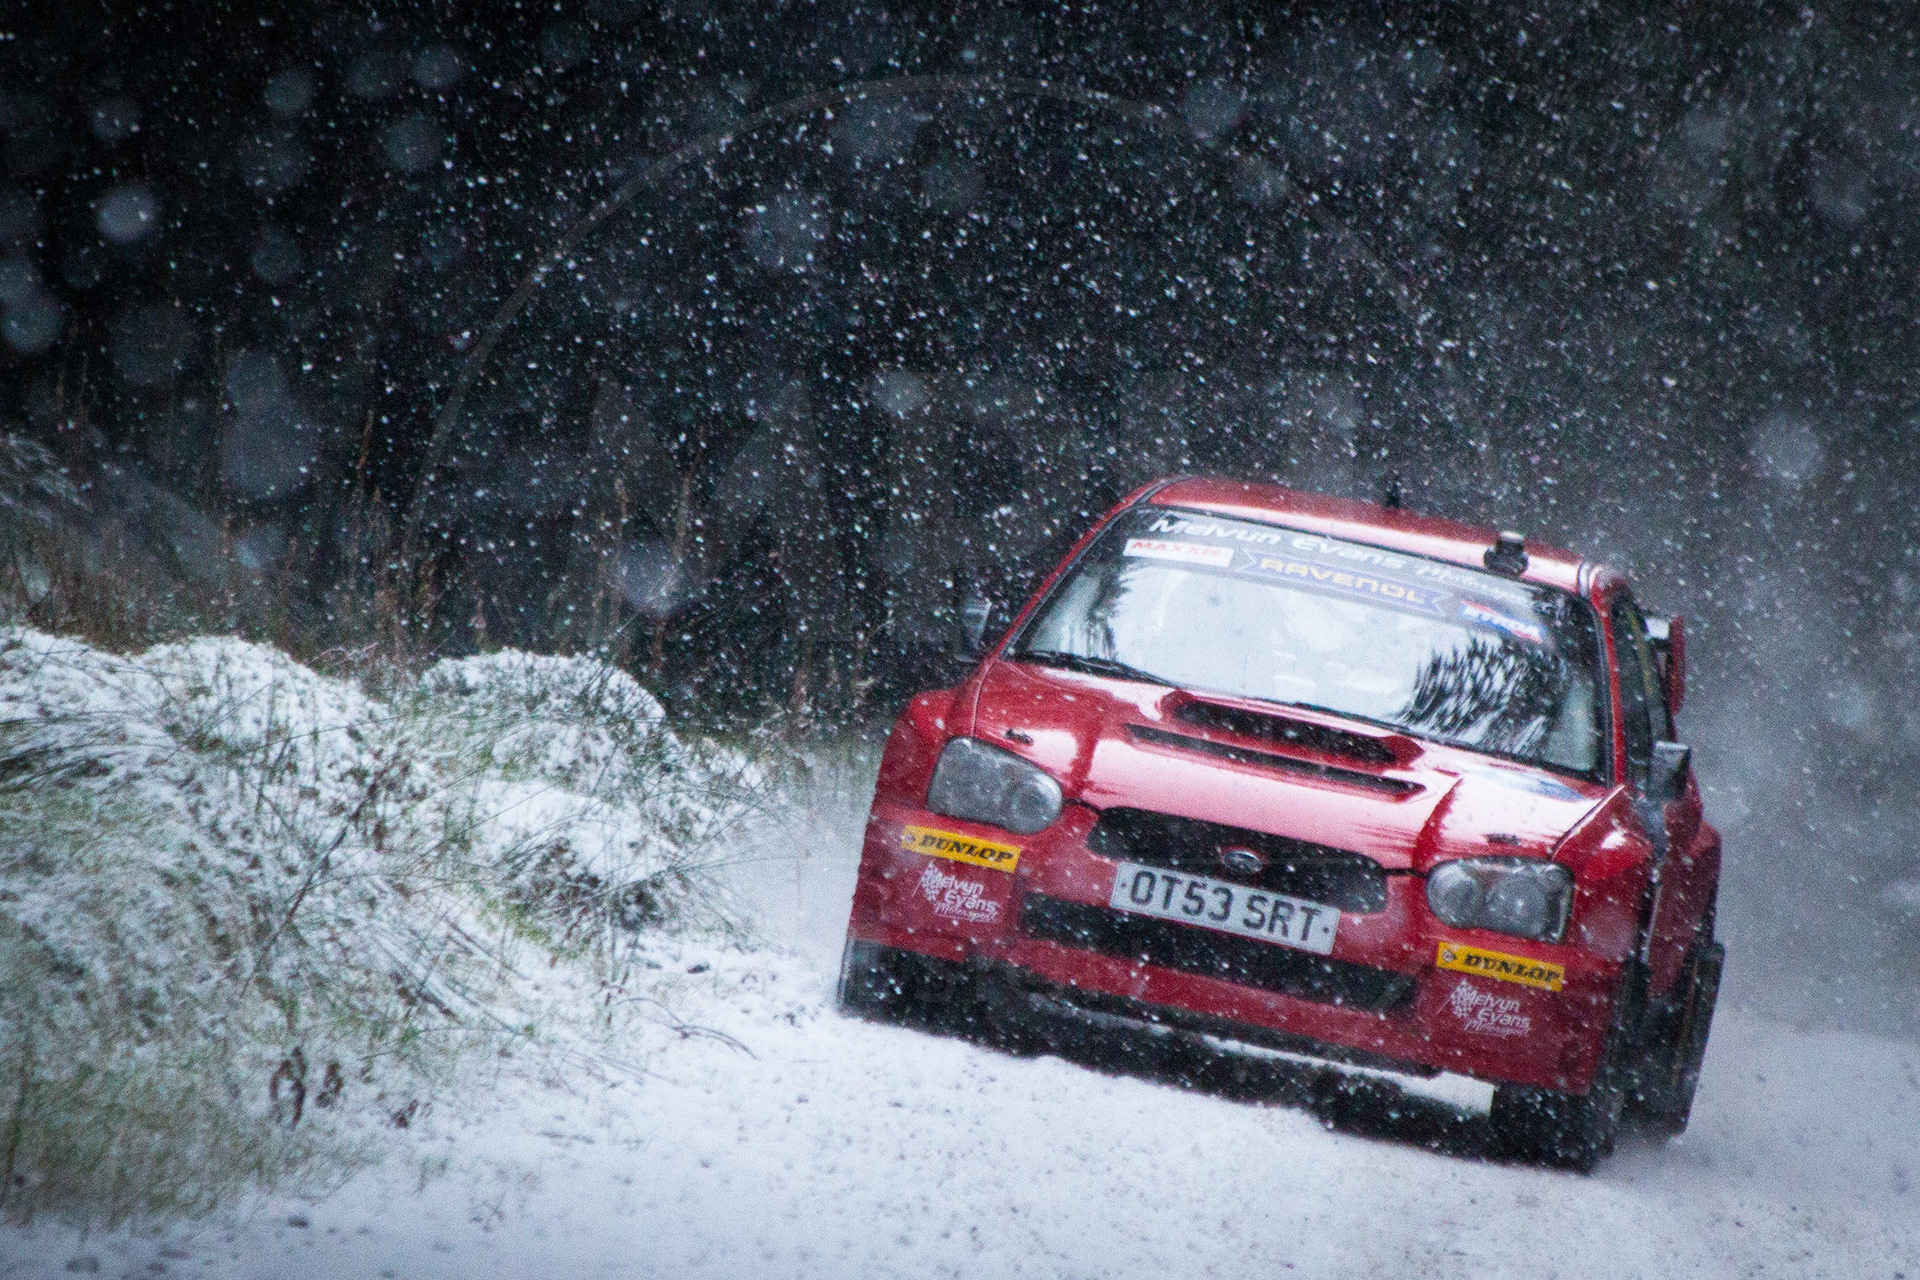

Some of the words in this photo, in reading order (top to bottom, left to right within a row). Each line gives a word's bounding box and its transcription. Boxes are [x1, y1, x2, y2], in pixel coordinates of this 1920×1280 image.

[1260, 558, 1425, 604] RAVENOL
[919, 834, 1014, 862] DUNLOP
[944, 890, 1000, 913] Evans
[1130, 870, 1234, 922] OT53
[1243, 894, 1322, 942] SRT
[1464, 954, 1561, 982] DUNLOP
[1477, 1008, 1531, 1028] Evans
